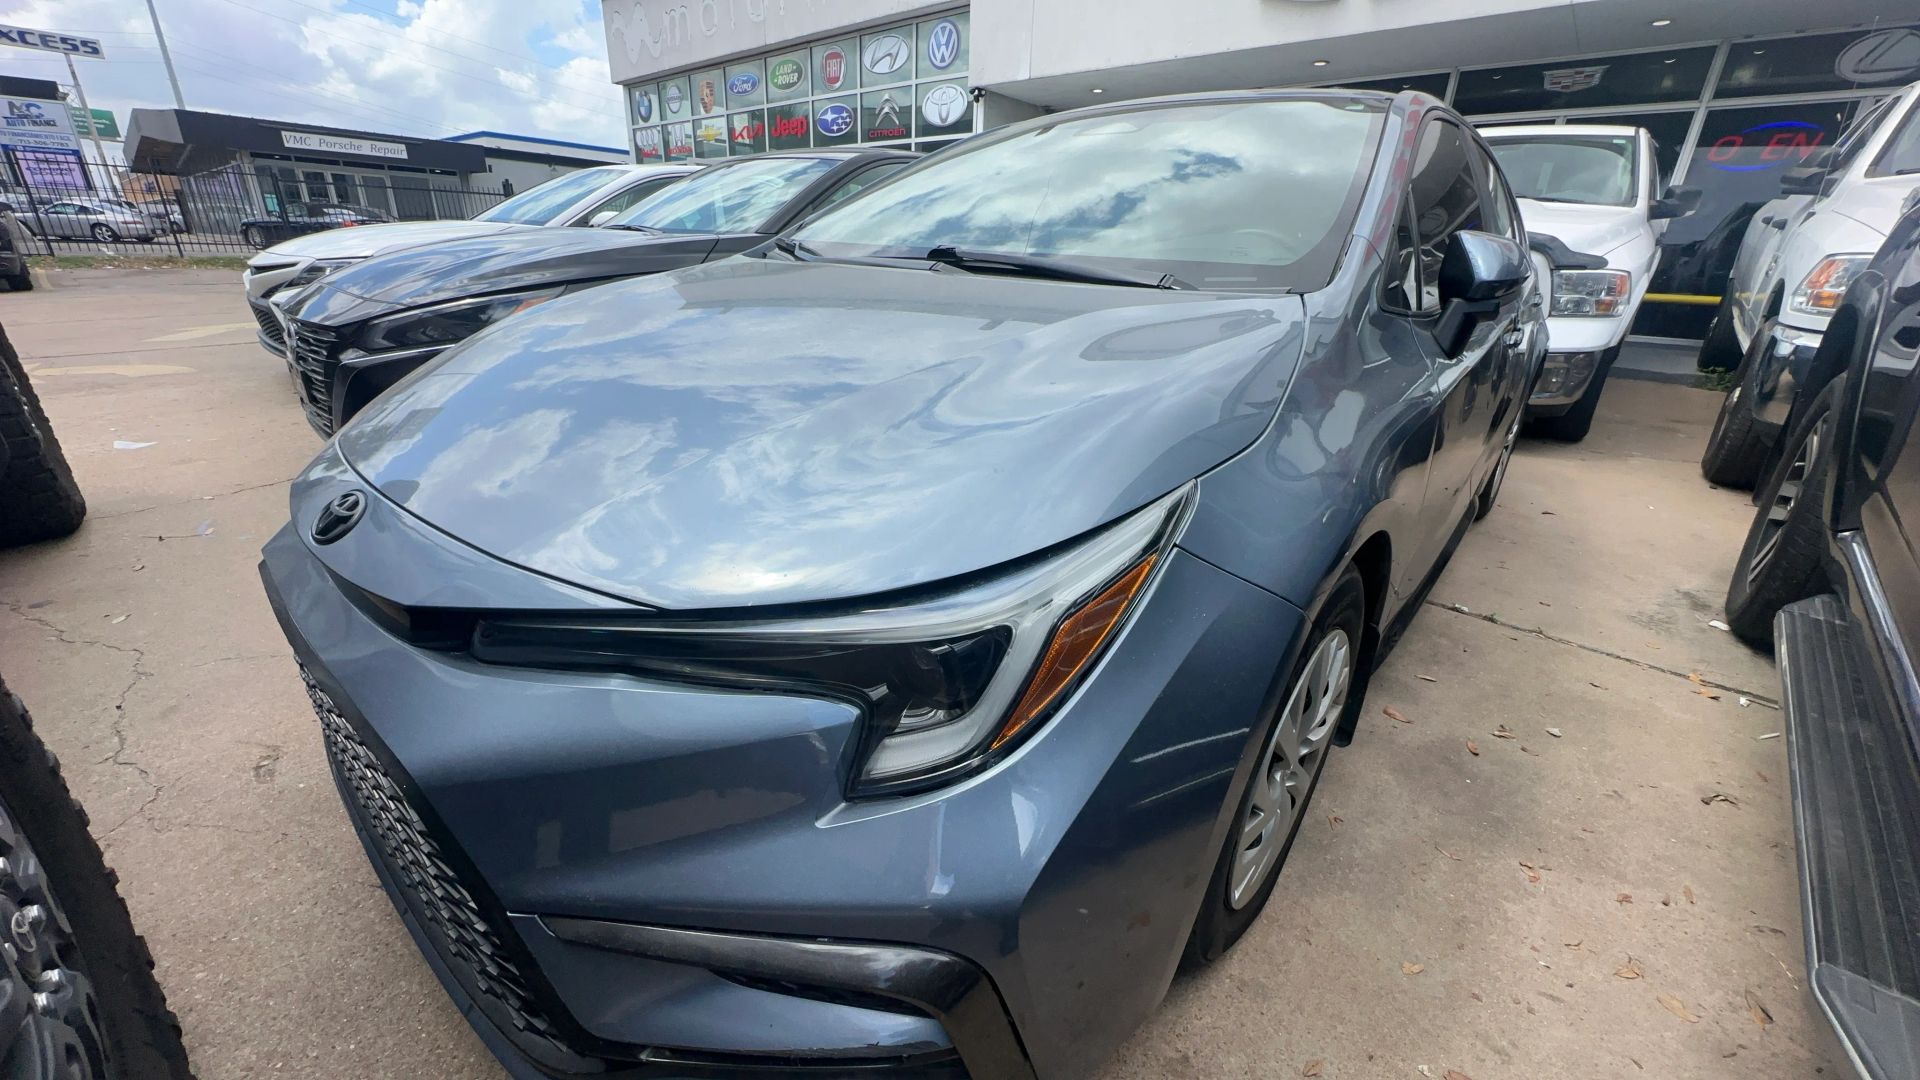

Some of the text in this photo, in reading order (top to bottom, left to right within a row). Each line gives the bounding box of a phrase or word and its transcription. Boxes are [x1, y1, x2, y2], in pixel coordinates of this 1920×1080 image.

[776, 63, 793, 75] LAND
[826, 59, 841, 78] FIAT
[733, 76, 753, 92] Ford
[778, 73, 798, 85] ROVER
[6, 119, 58, 127] AUTO FINANCE
[771, 115, 808, 138] Jeep
[284, 134, 405, 156] VMC Porsche Repair
